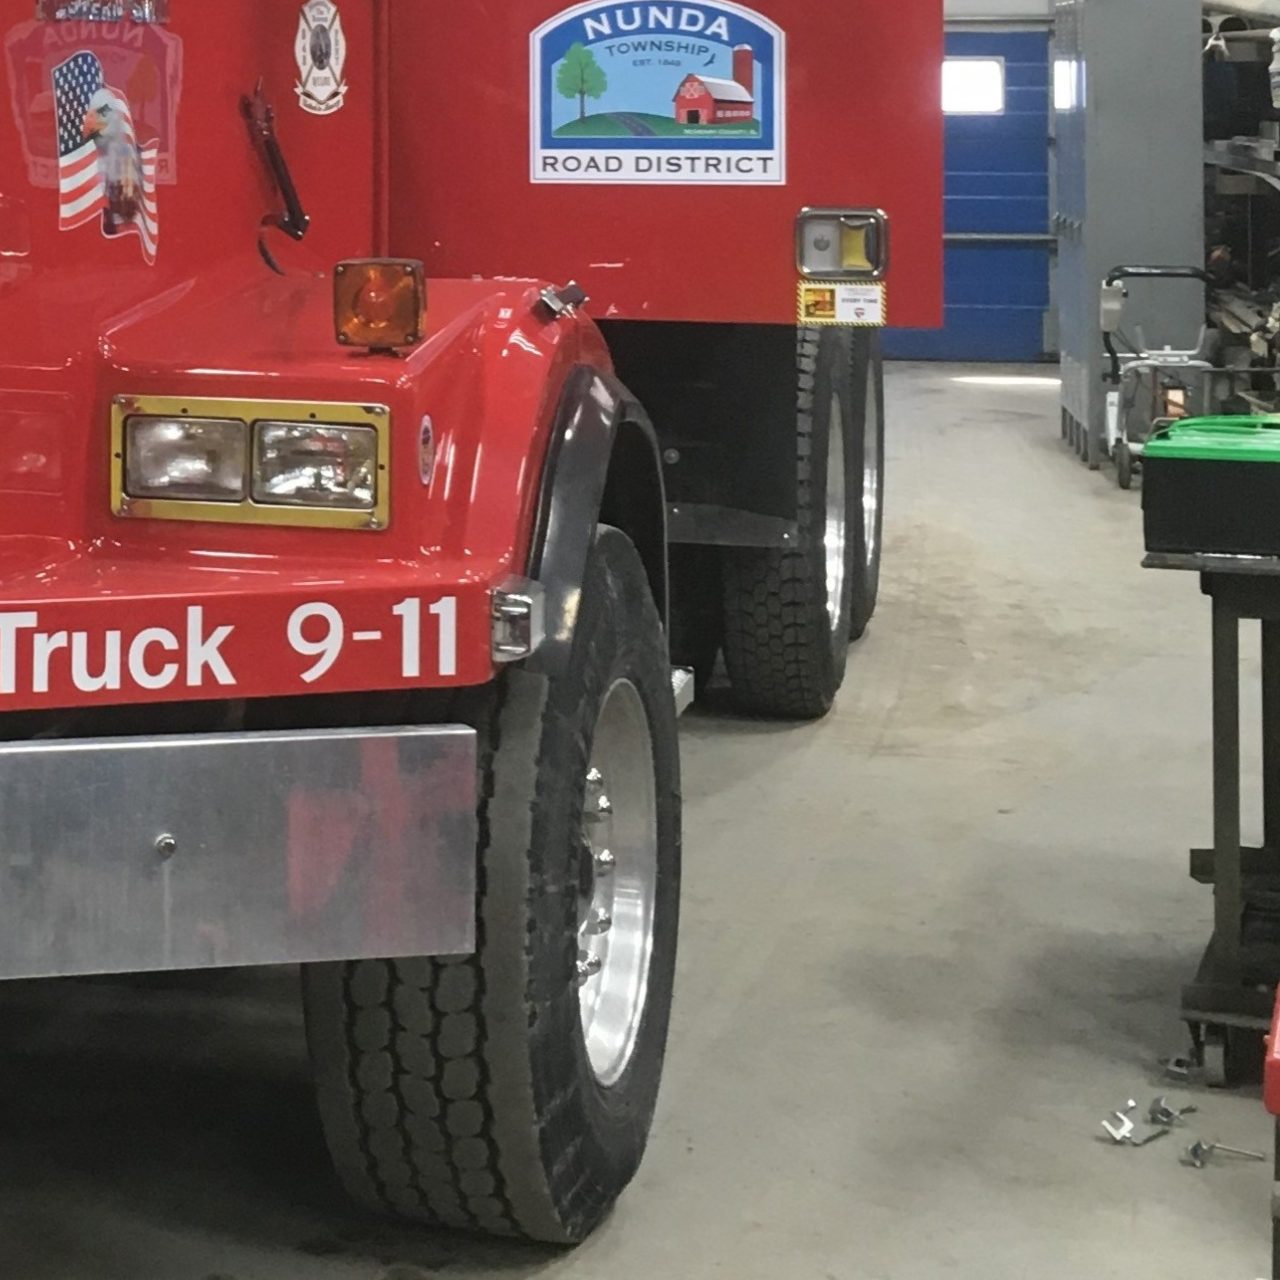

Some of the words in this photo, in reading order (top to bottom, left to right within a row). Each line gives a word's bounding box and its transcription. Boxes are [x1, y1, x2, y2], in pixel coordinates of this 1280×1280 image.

[582, 5, 730, 41] NUNDA
[605, 40, 710, 57] TOWNSHIP
[541, 156, 624, 173] ROAD
[634, 156, 774, 174] DISTRICT
[286, 596, 458, 683] 9-11
